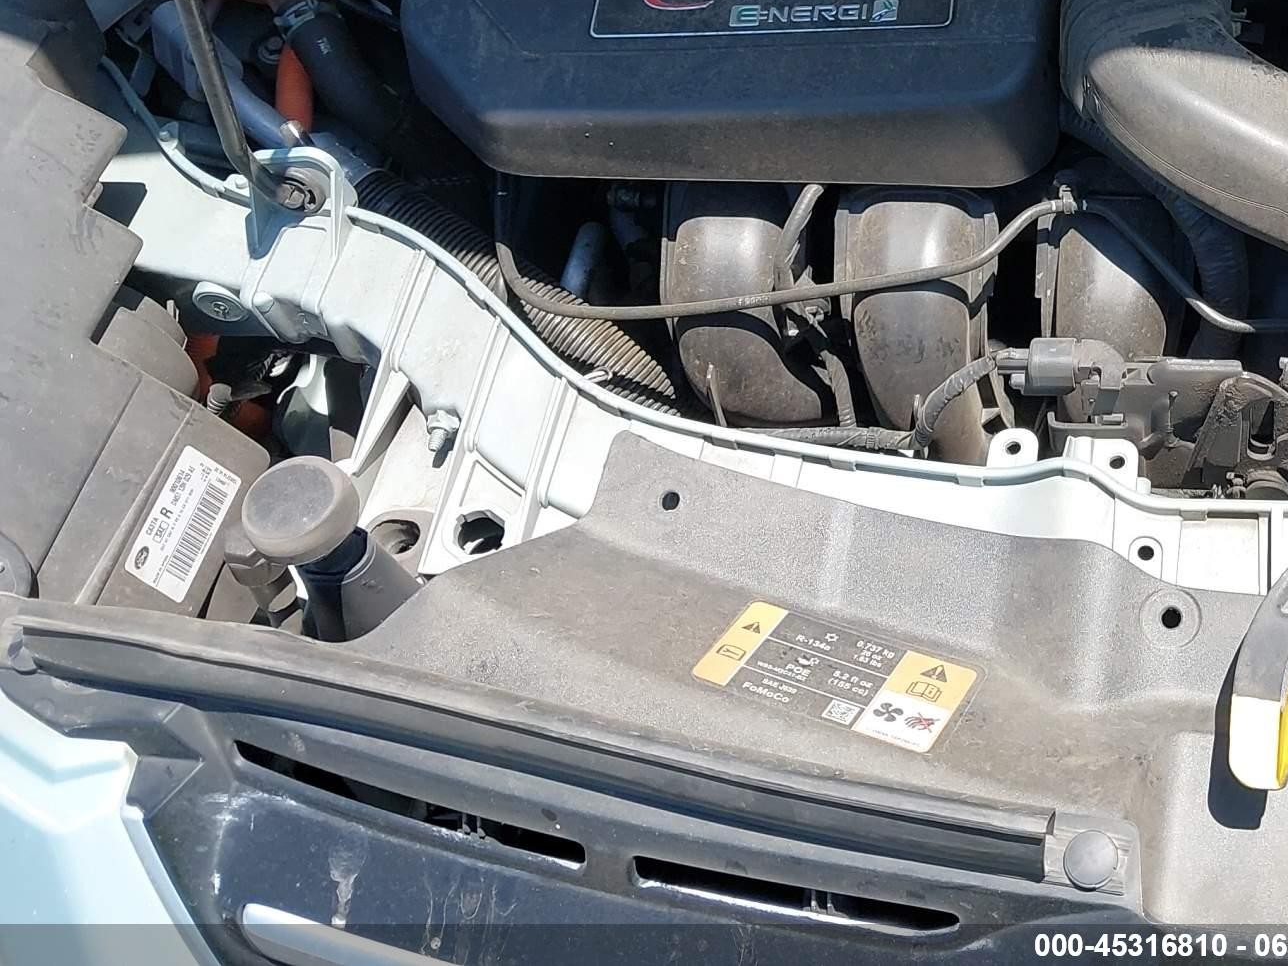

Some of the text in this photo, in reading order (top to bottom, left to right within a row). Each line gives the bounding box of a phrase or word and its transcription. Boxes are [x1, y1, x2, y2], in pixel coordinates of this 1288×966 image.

[160, 507, 173, 519] R
[883, 649, 895, 659] kg
[870, 660, 882, 668] lbs
[786, 664, 812, 677] POE
[762, 678, 778, 688] SAE
[860, 680, 873, 688] oz
[742, 681, 790, 703] FoMoCo
[852, 687, 868, 696] cc)
